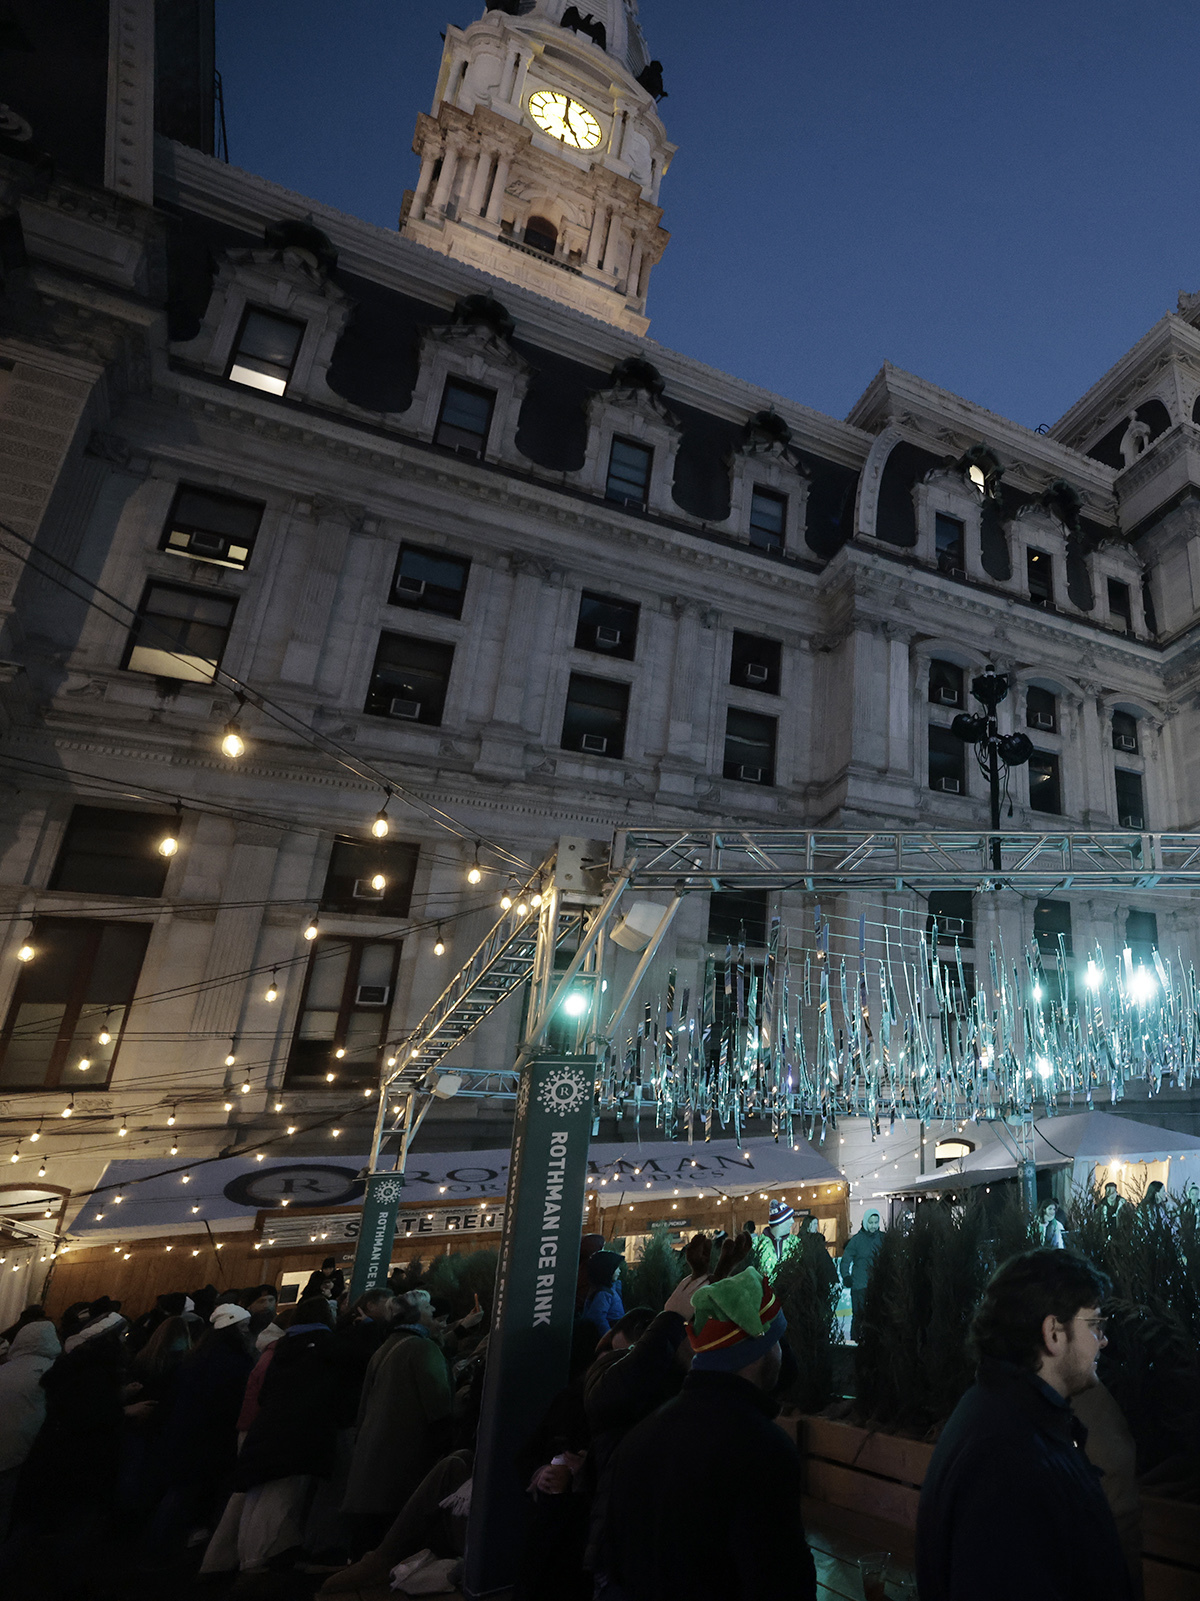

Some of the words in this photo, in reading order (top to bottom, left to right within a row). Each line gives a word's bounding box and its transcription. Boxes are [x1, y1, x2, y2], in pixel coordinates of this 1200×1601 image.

[542, 1131, 569, 1230] ROTHMAN
[370, 1211, 389, 1261] ROTHMAN
[538, 1236, 559, 1269] ICE
[367, 1262, 380, 1280] ICE
[532, 1274, 555, 1328] RINK
